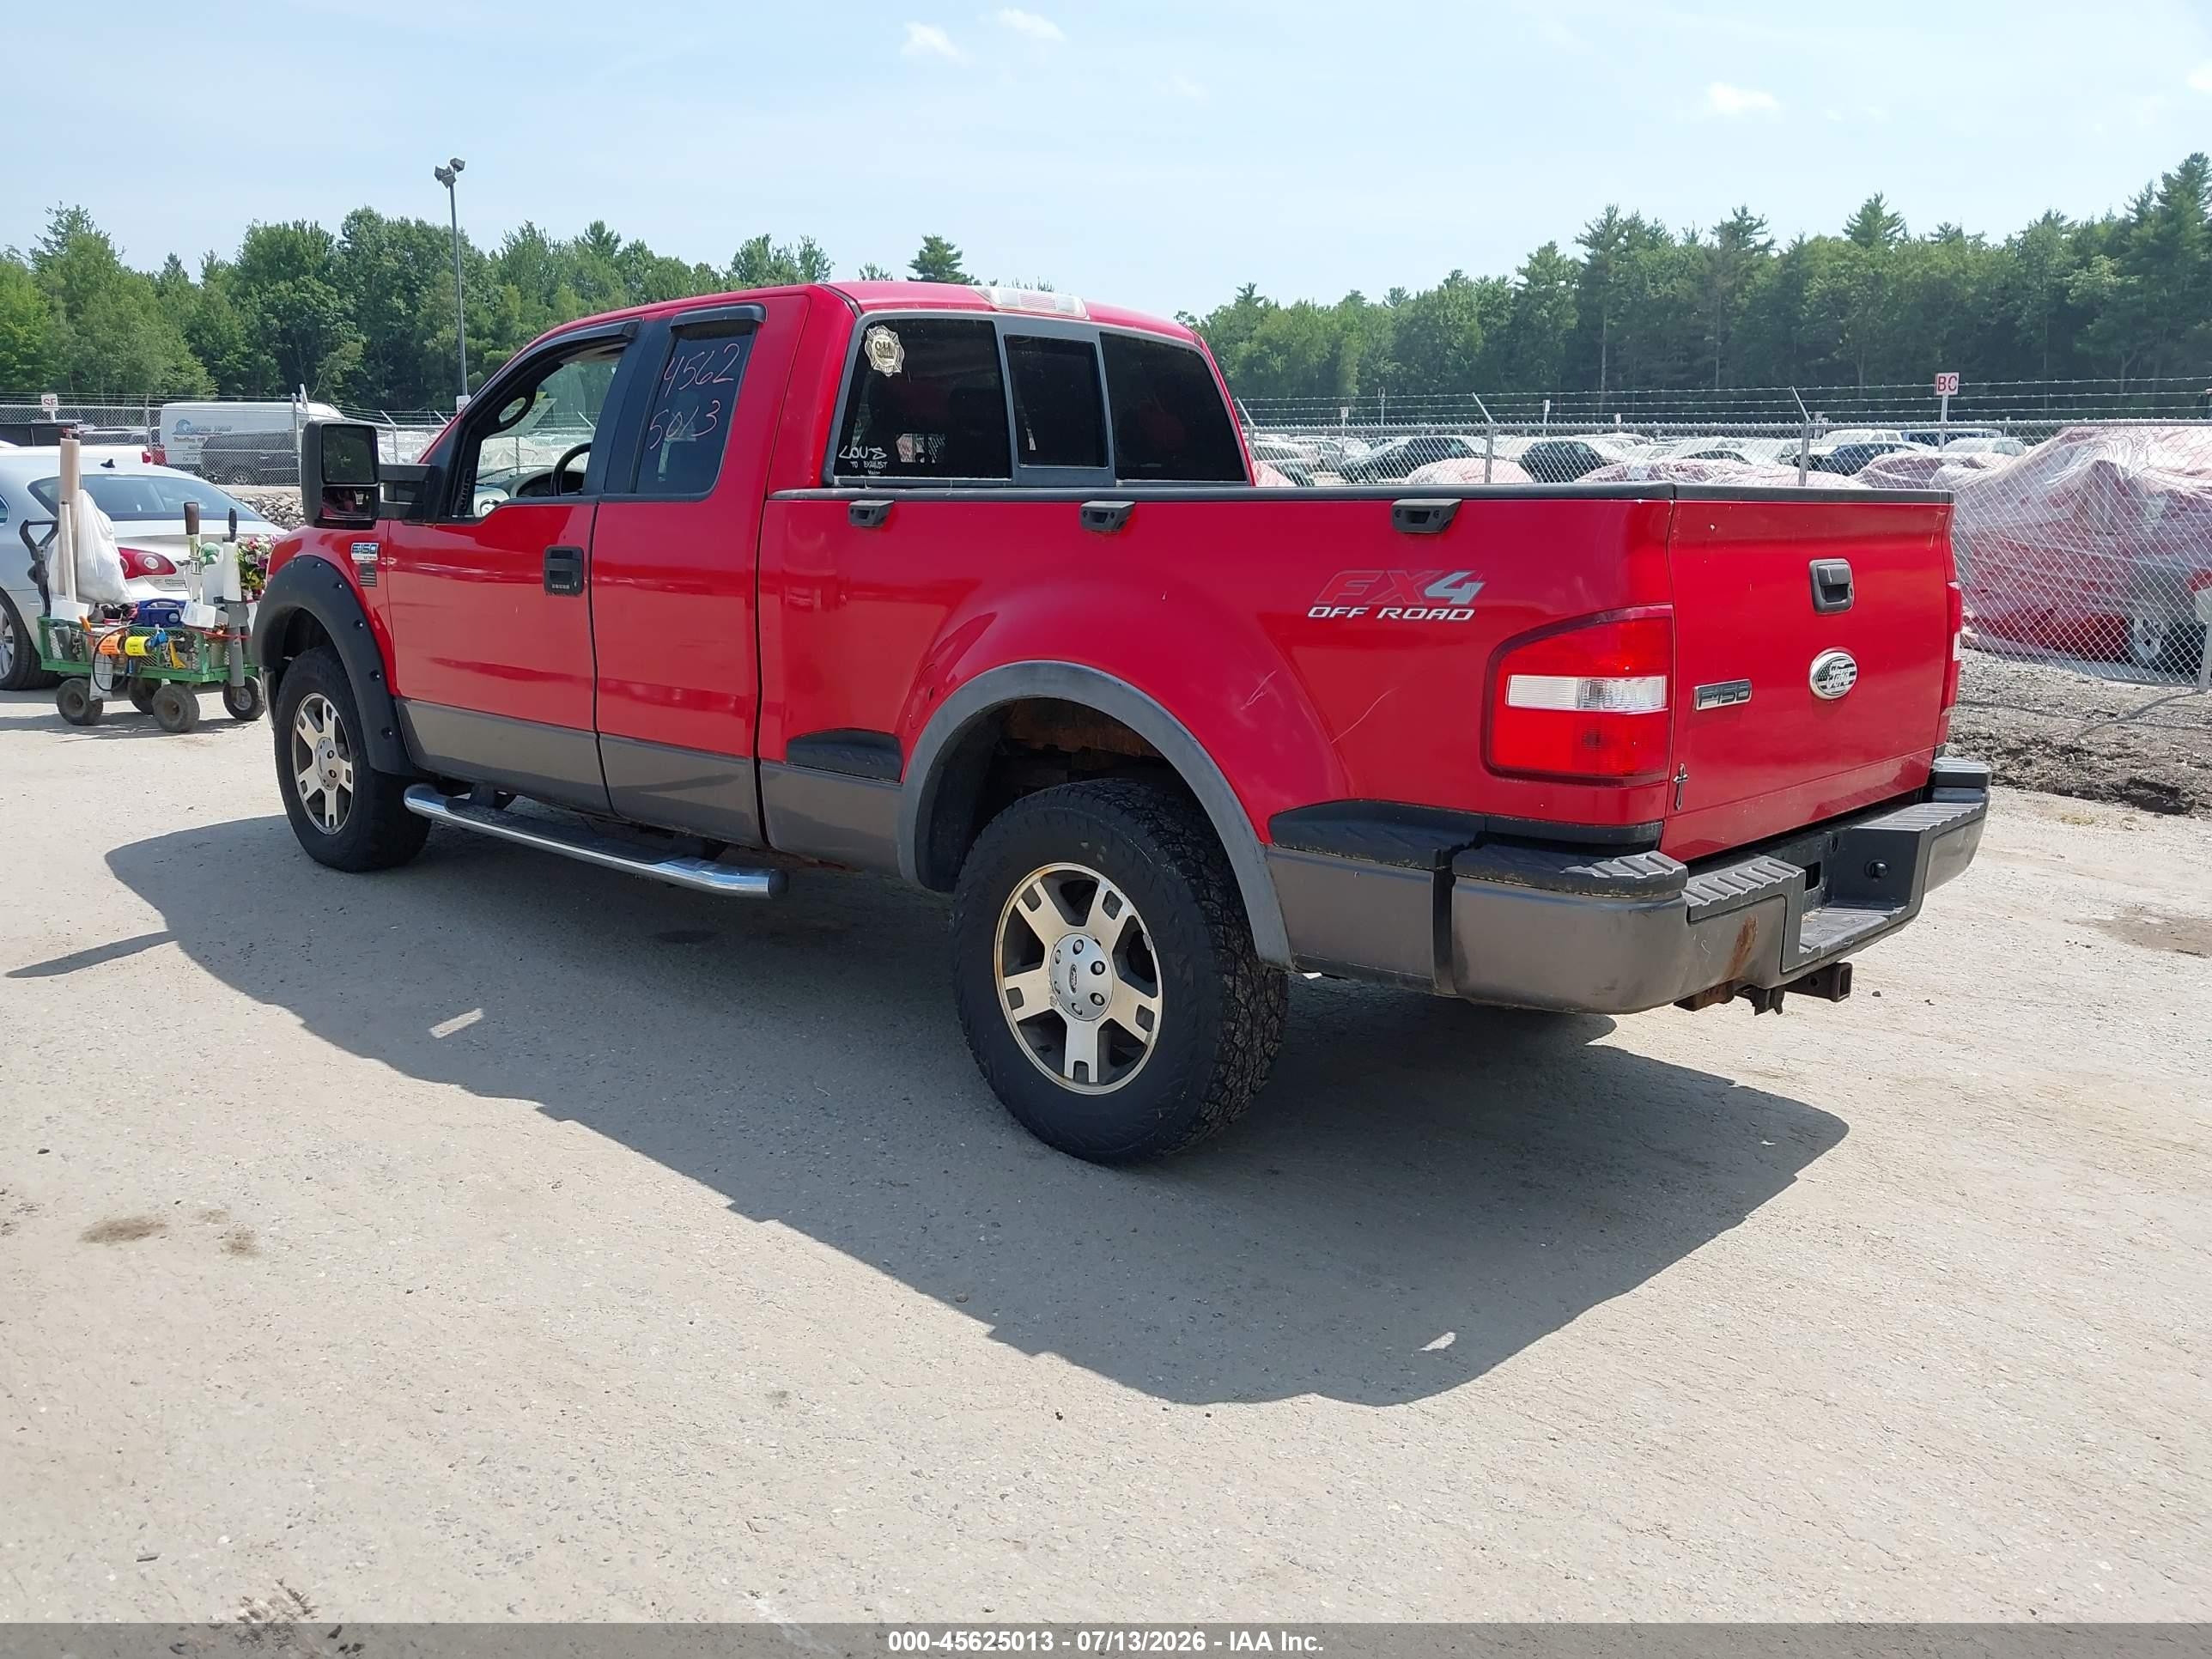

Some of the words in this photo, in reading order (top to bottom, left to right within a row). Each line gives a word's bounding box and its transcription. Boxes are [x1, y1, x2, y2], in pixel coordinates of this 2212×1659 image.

[663, 343, 740, 398] 4562
[1937, 375, 1958, 392] BC
[1314, 569, 1486, 605] FX4
[1308, 606, 1370, 618] OFF
[1376, 607, 1475, 621] ROAD
